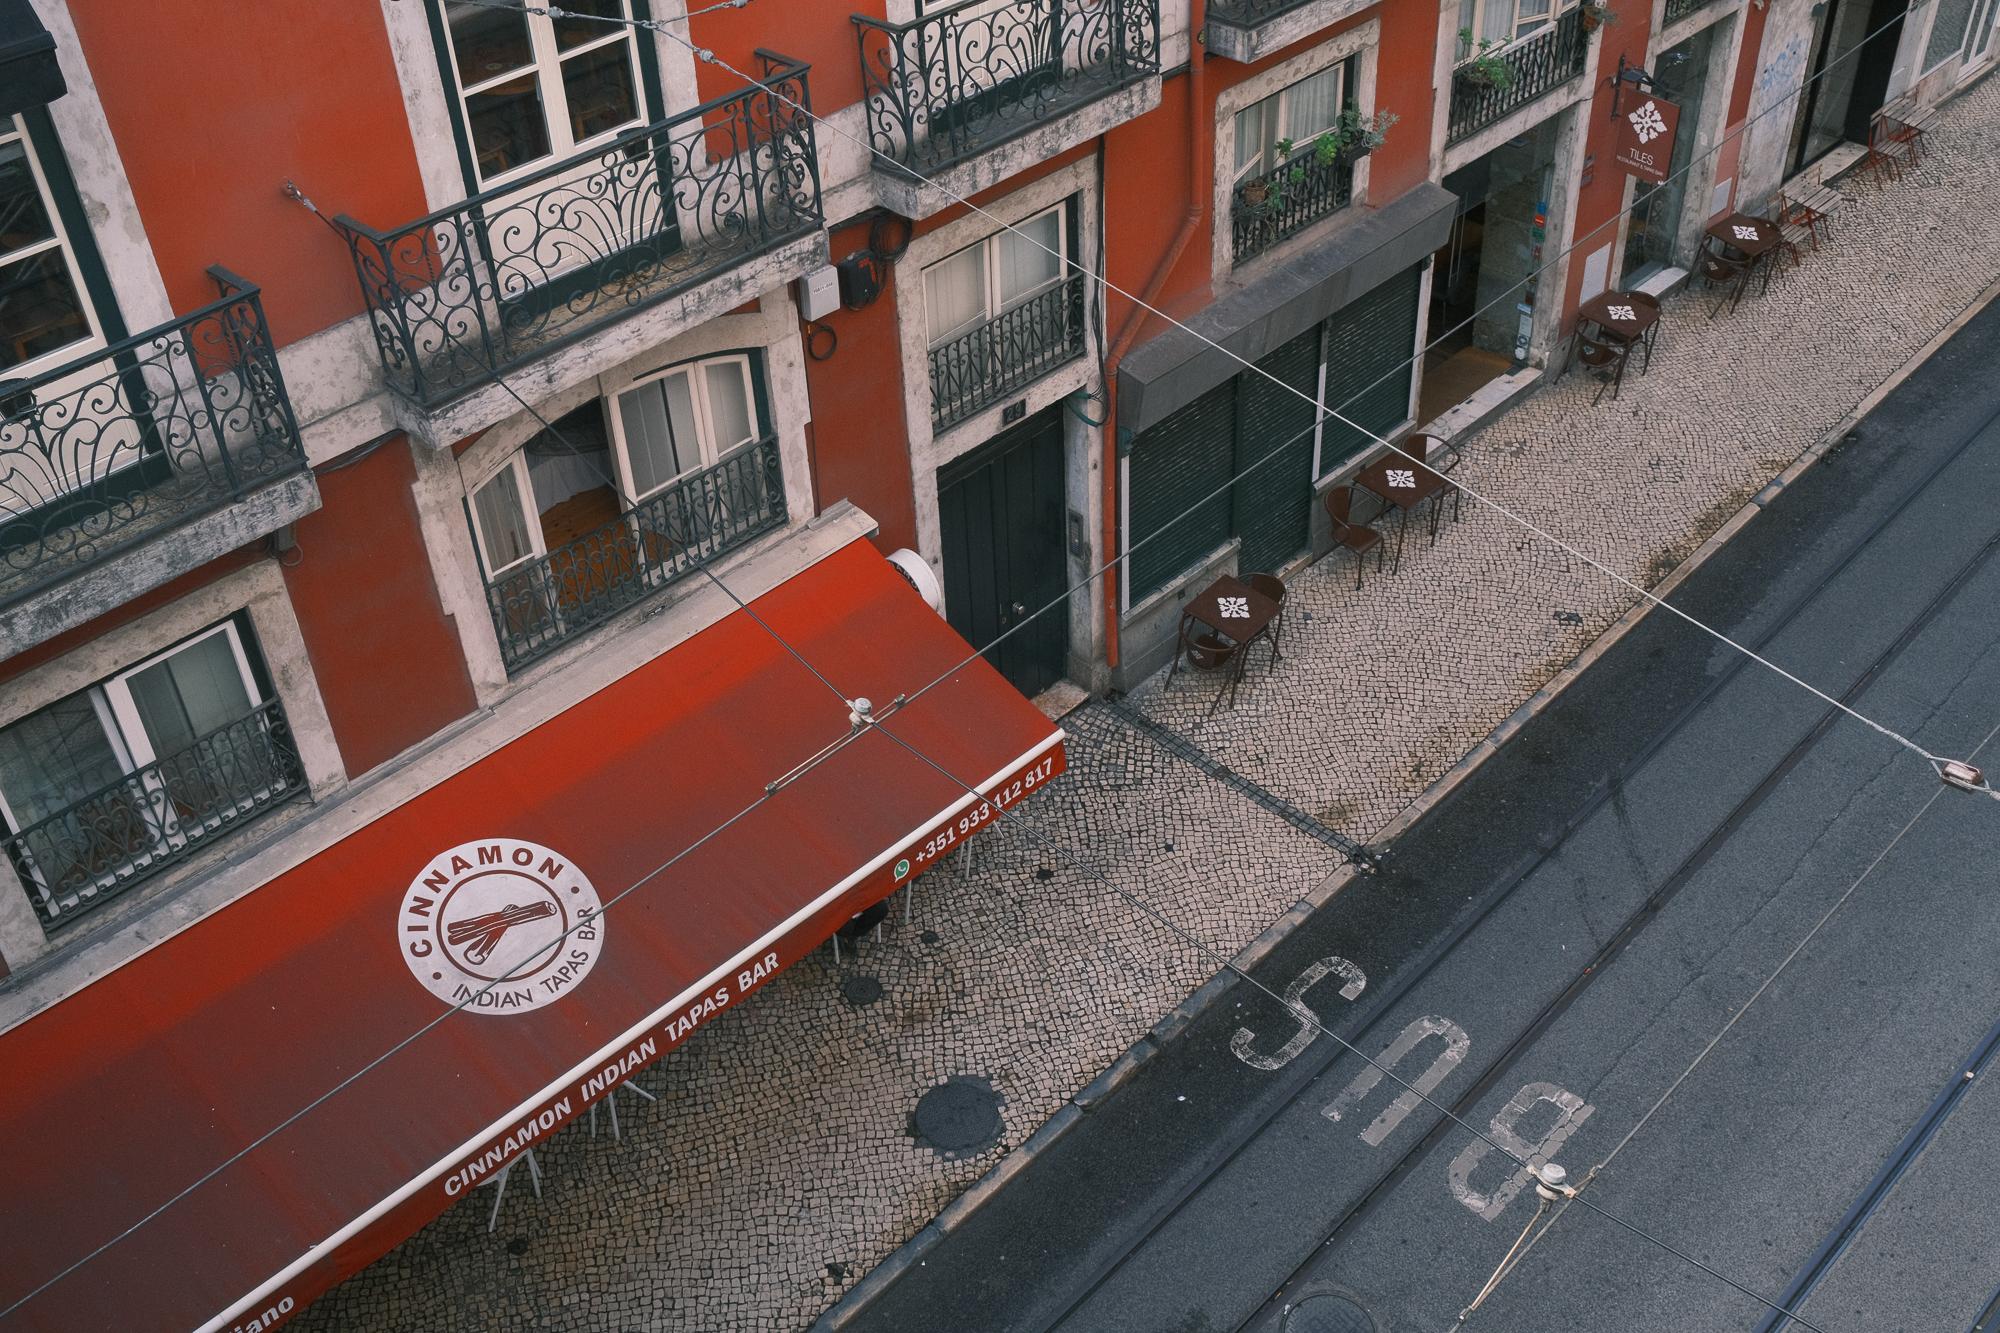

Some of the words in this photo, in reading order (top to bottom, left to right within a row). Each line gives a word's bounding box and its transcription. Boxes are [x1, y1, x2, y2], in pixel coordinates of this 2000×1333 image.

[1630, 148, 1654, 166] TILES
[915, 826, 957, 862] +351
[959, 802, 990, 834] 933
[994, 781, 1022, 812] 112
[1025, 757, 1053, 789] 817
[407, 845, 565, 958] CINNAMON
[452, 983, 534, 1008] INDIAN
[540, 949, 589, 994] TAPAS
[577, 906, 596, 941] BAR
[444, 1099, 572, 1196] CINNAMON
[581, 1037, 657, 1102] INDIAN
[664, 986, 730, 1042] TAPAS
[737, 952, 780, 993] BAR
[1230, 956, 1597, 1222] BUS
